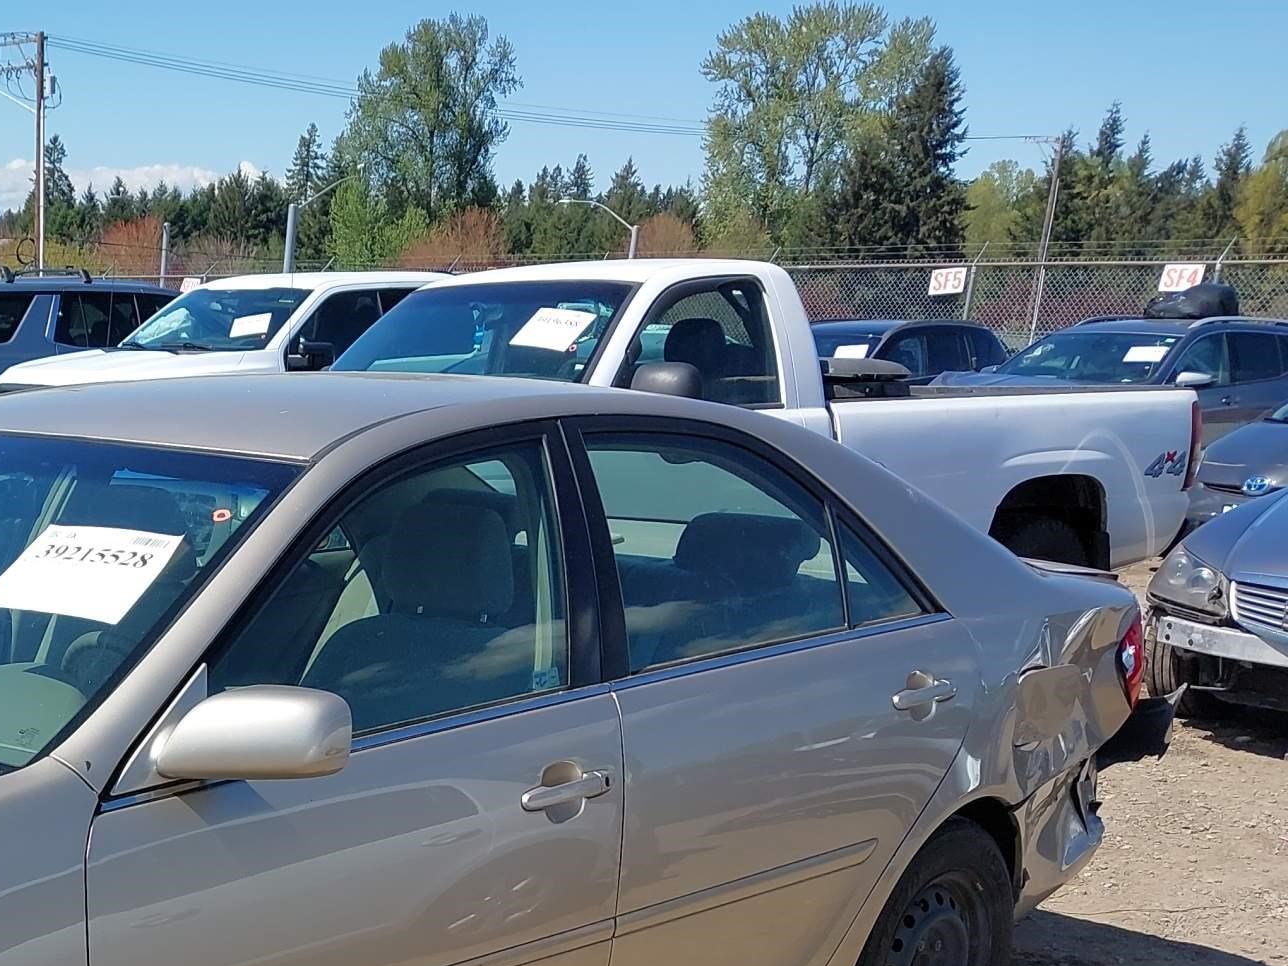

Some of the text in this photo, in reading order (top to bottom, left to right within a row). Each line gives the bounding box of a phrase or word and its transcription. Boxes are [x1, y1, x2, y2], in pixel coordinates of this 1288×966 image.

[933, 270, 963, 291] SF5
[1163, 268, 1199, 288] SF4
[35, 544, 154, 568] 39215528
